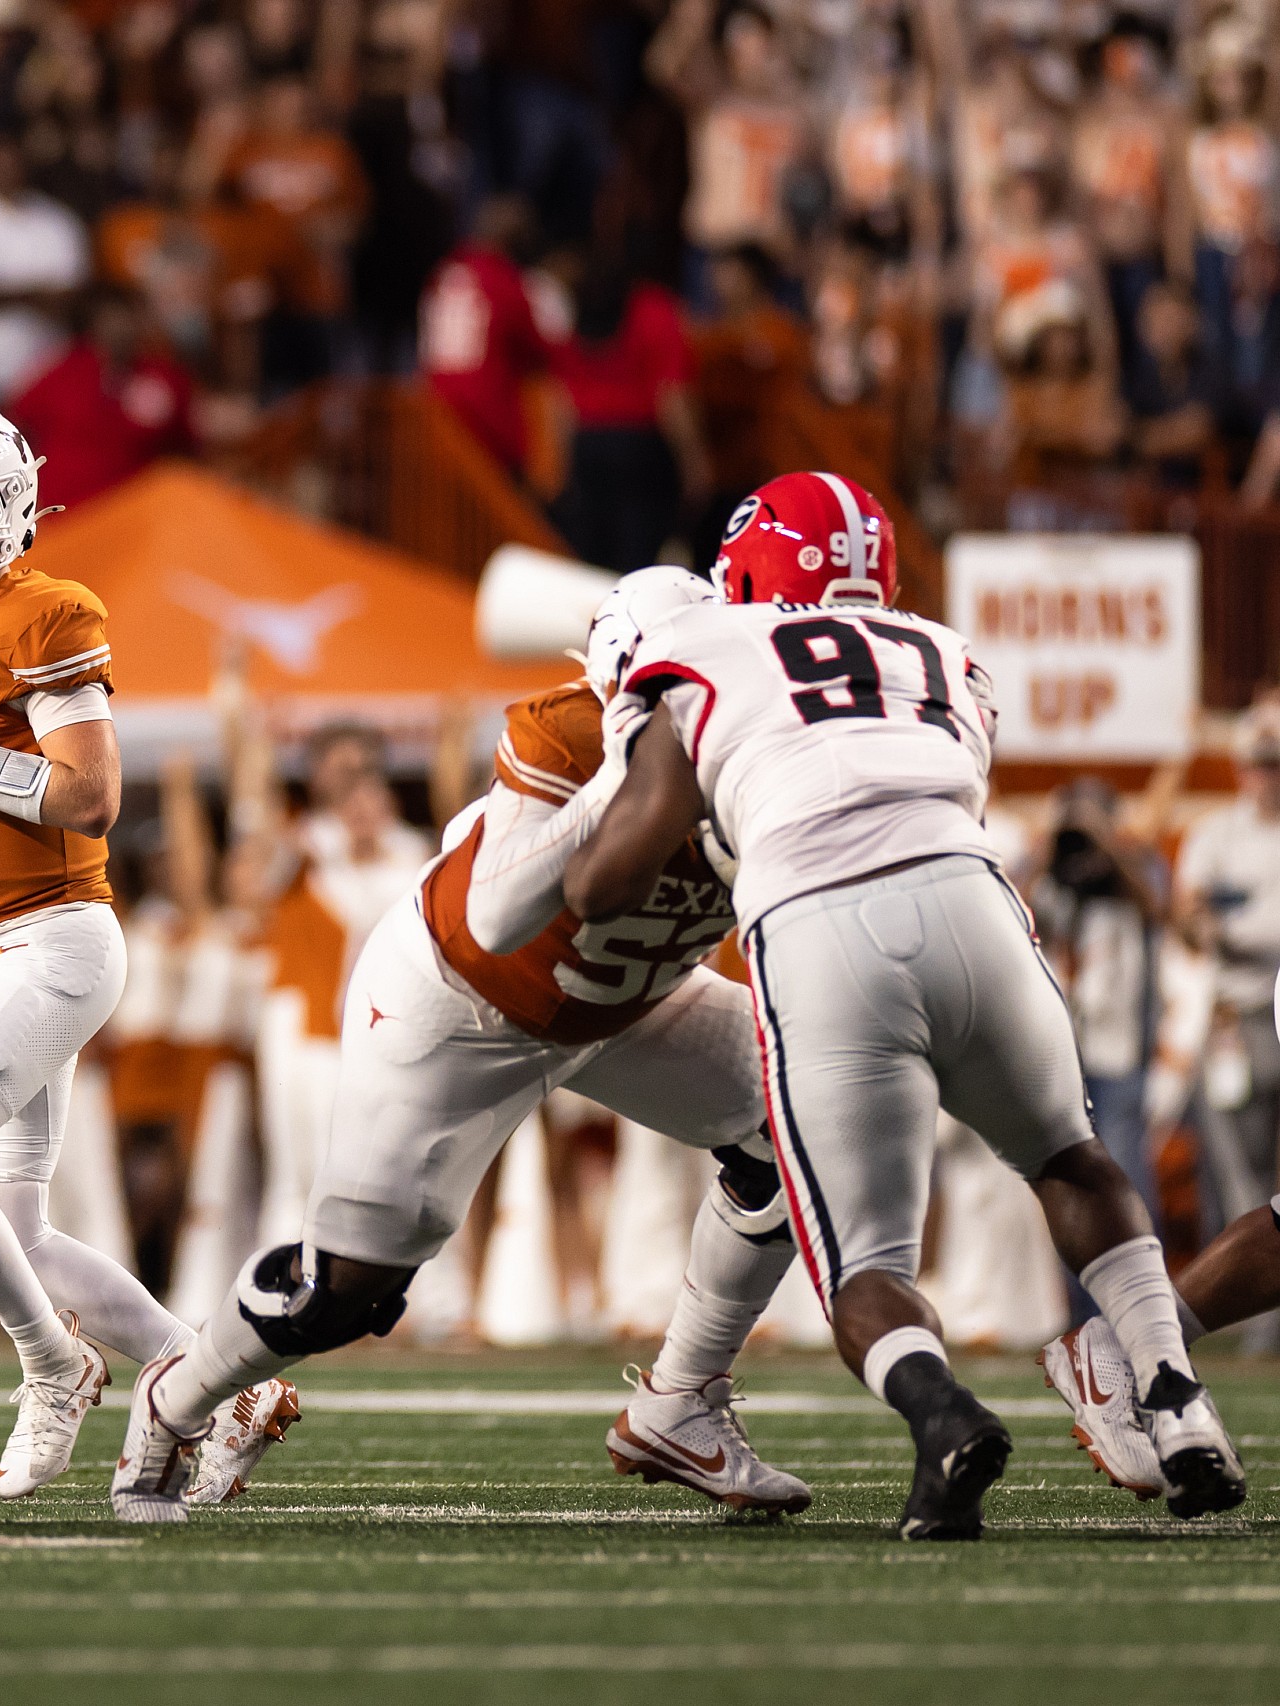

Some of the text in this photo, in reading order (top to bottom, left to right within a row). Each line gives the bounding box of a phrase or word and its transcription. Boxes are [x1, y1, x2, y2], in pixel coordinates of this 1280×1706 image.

[829, 531, 881, 569] 97
[977, 586, 1167, 642] HORNS
[770, 616, 961, 742] 97
[1028, 675, 1117, 729] UP
[642, 875, 734, 914] EXA
[553, 915, 737, 1005] 52
[232, 1386, 261, 1431] NIKE
